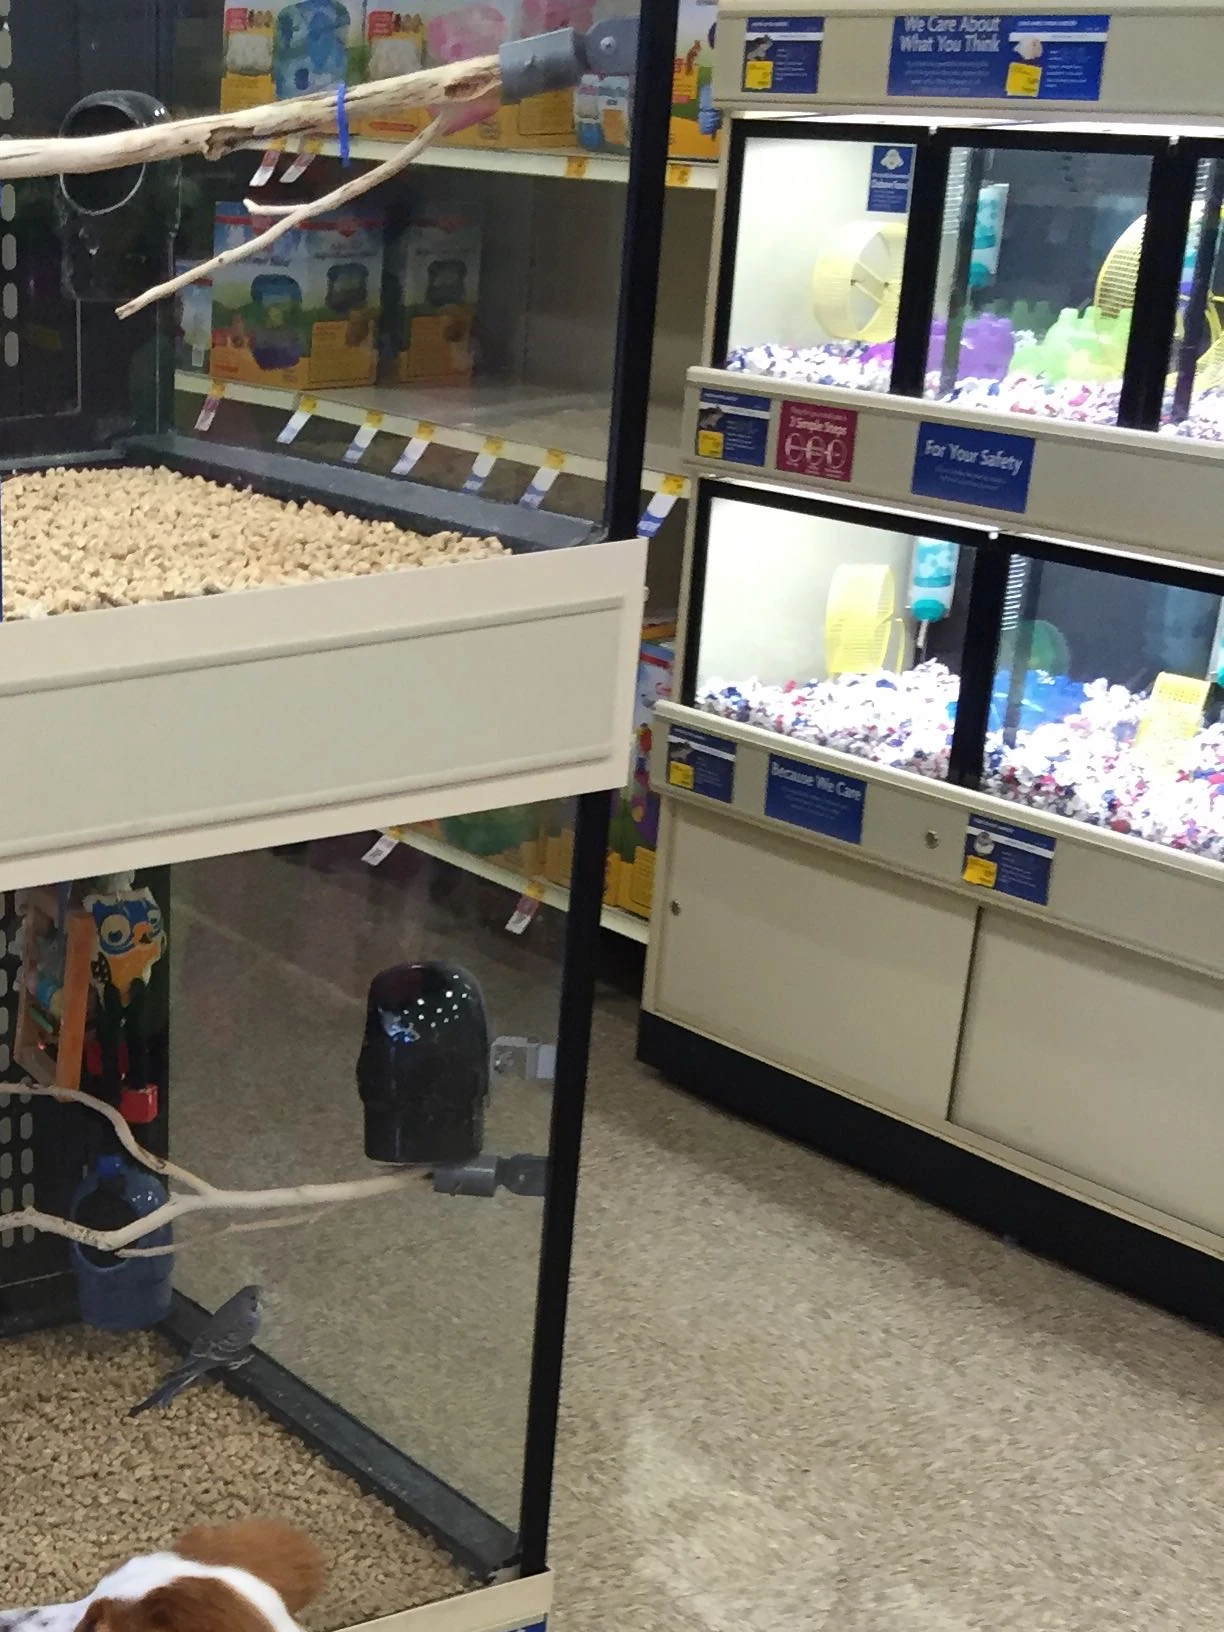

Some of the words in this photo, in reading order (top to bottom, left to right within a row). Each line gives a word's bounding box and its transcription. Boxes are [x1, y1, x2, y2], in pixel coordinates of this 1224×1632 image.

[904, 16, 925, 32] We
[928, 16, 957, 32] Care
[959, 16, 1001, 32] About
[900, 34, 933, 52] What
[937, 36, 962, 52] You
[965, 35, 1001, 52] Think
[924, 440, 947, 458] For
[948, 443, 979, 463] Your
[979, 449, 1024, 476] Safety
[836, 781, 862, 801] Care
